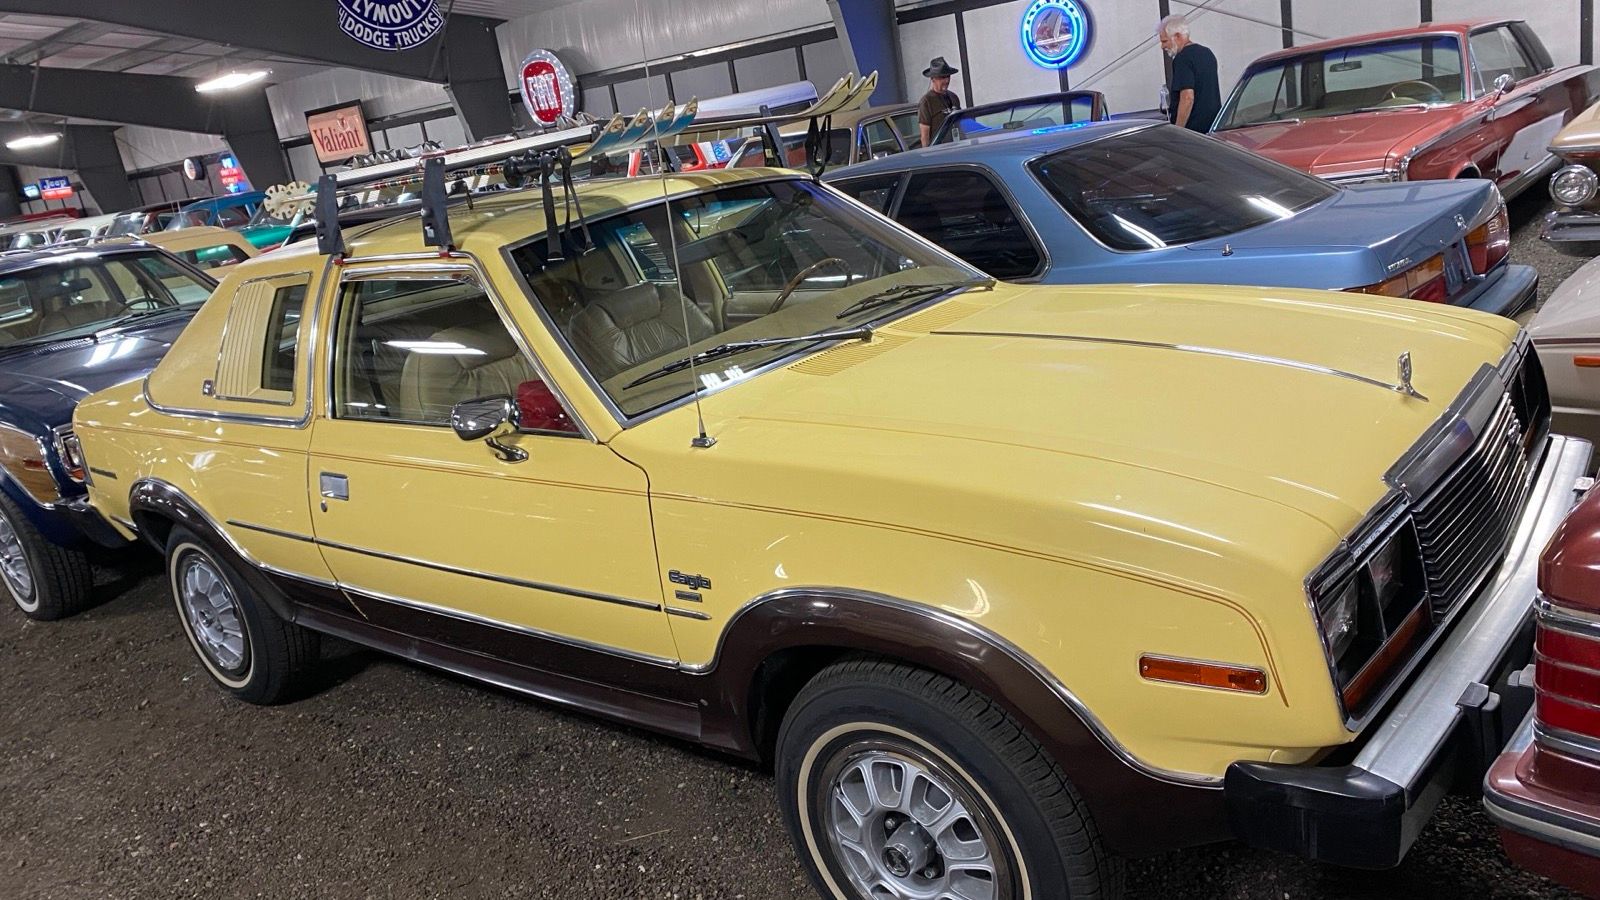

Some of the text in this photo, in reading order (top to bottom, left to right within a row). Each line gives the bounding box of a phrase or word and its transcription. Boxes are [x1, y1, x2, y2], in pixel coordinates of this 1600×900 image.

[351, 0, 429, 24] LYMOUT
[344, 12, 440, 47] DODGE TRUCKS
[526, 73, 559, 111] FIAT
[313, 126, 364, 153] Valiant
[43, 179, 67, 190] Jeep
